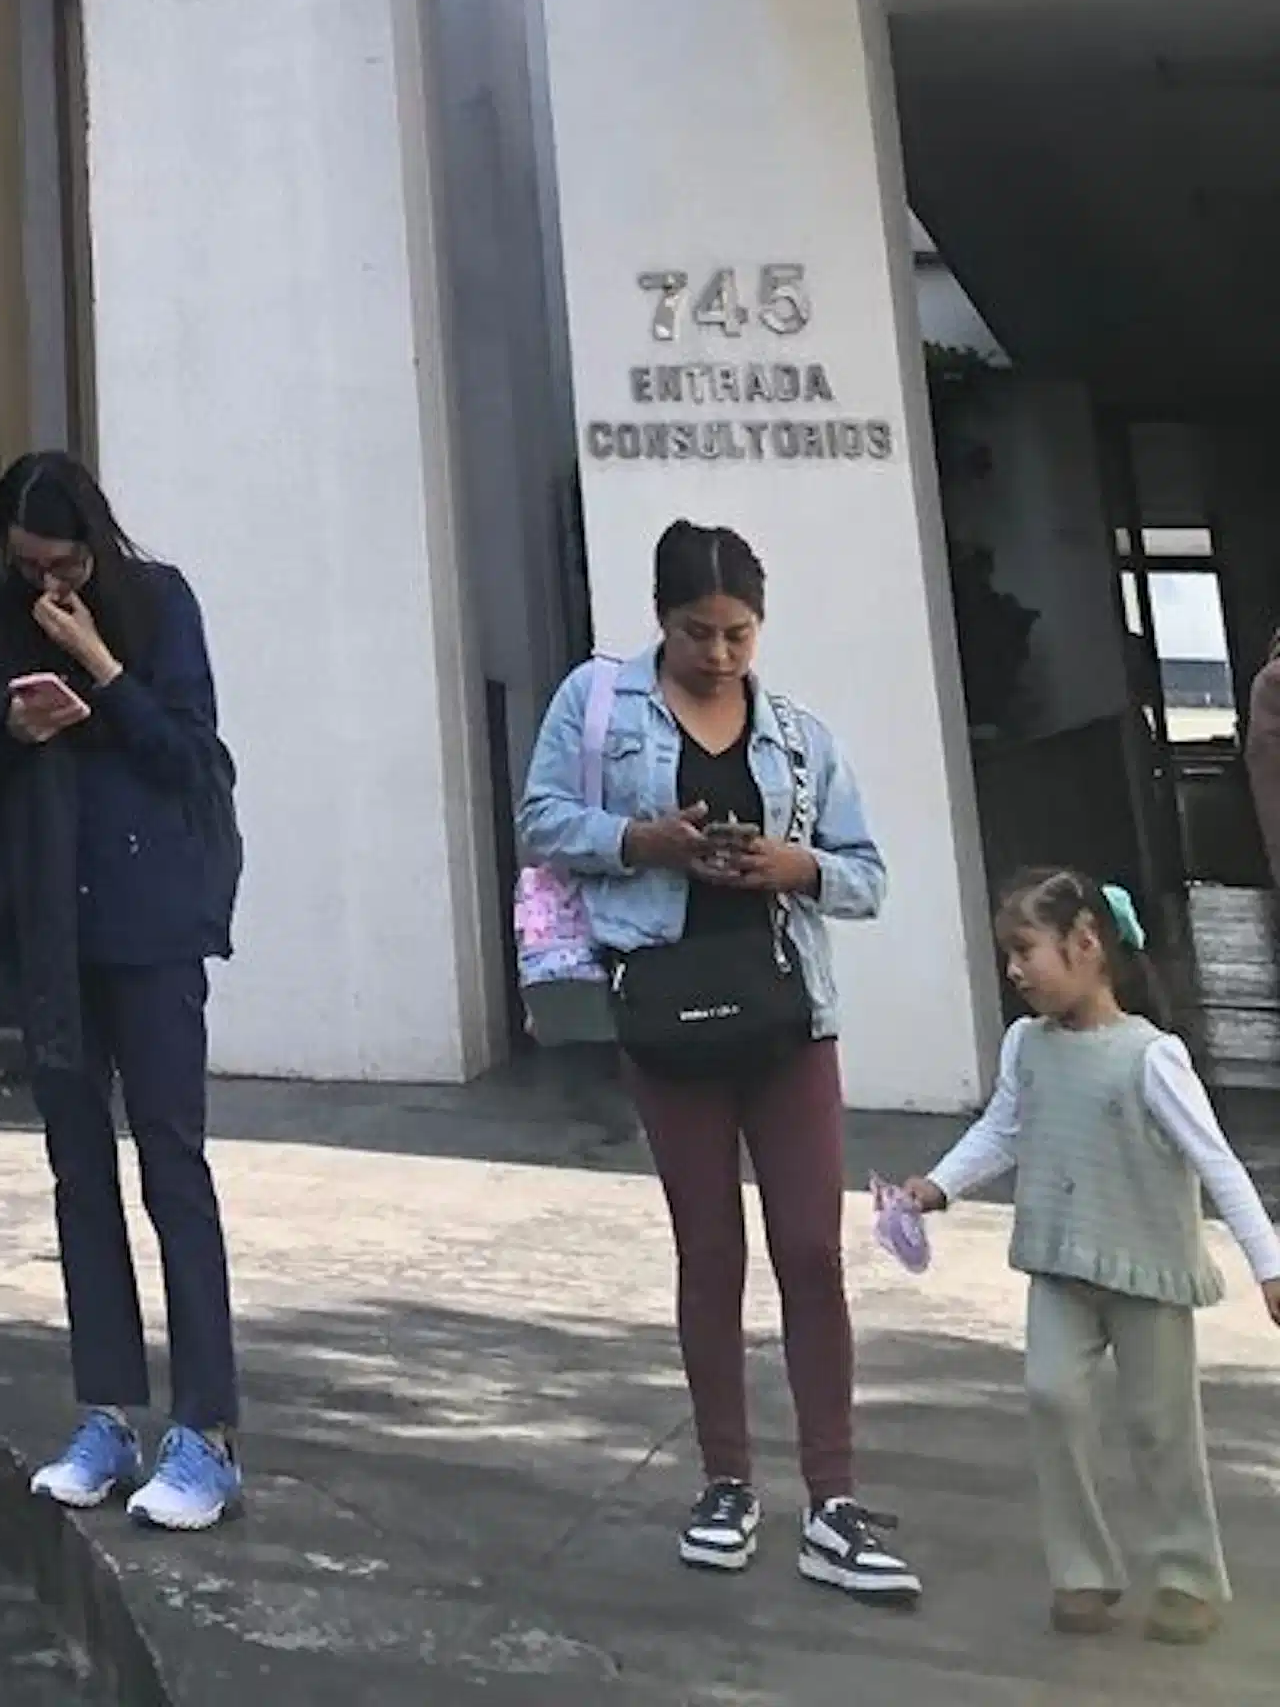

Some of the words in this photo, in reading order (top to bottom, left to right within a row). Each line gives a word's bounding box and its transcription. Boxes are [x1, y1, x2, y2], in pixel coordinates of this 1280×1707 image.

[637, 262, 812, 341] 745
[630, 363, 835, 403] ENTRADA
[588, 420, 893, 461] CONSULTORIOS
